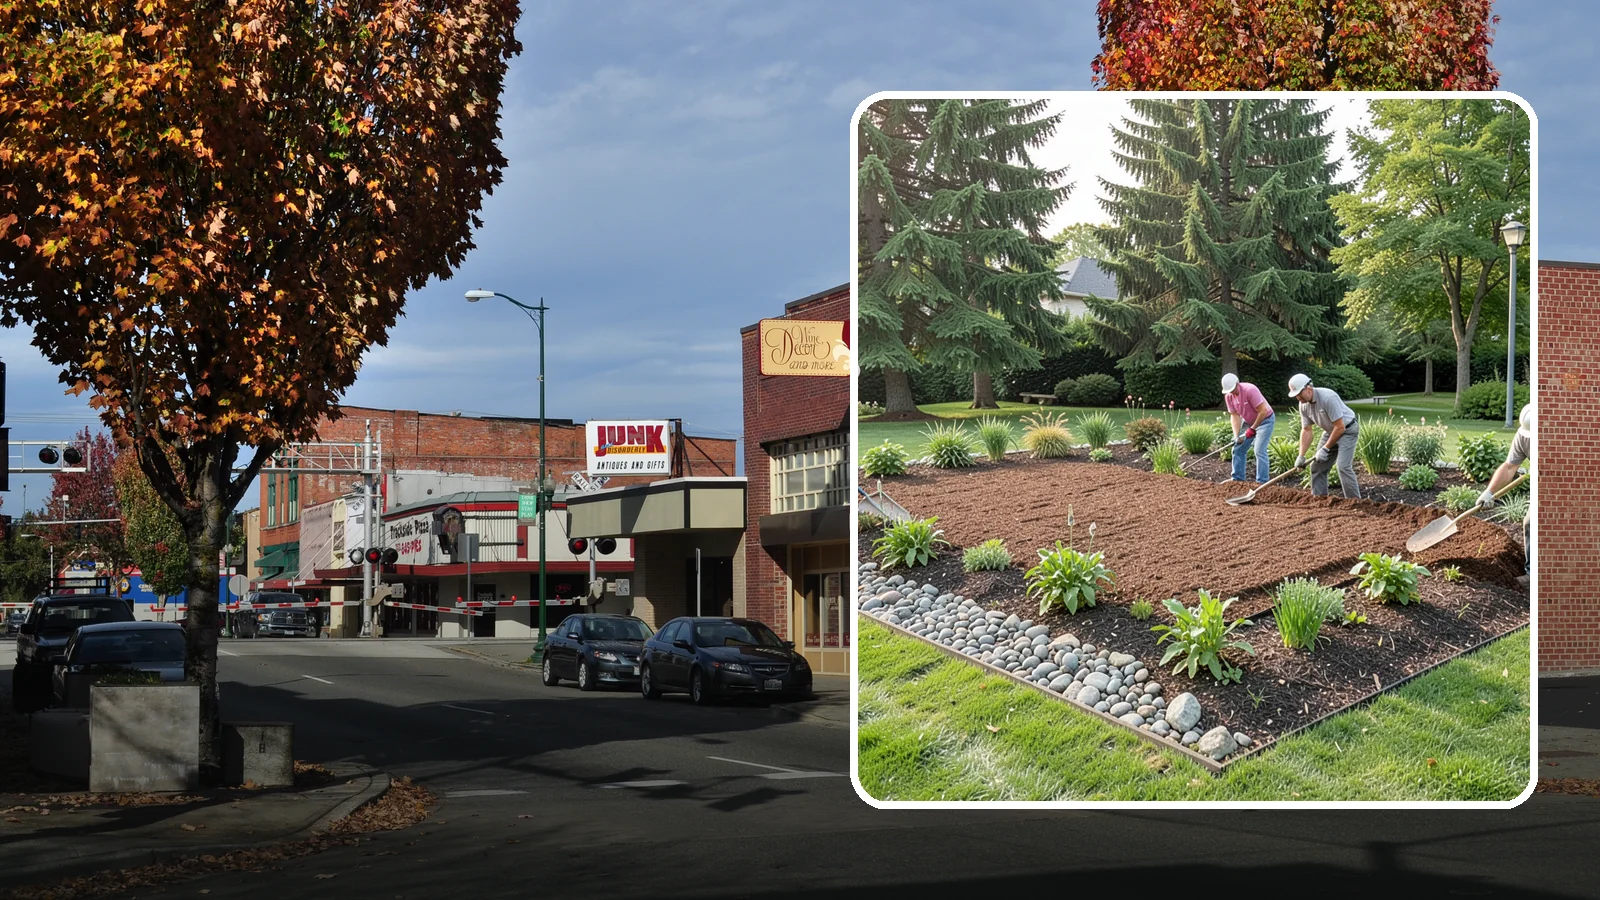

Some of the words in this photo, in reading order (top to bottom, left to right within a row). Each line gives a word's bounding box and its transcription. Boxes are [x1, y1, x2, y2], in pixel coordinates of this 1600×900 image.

[595, 425, 664, 457] JUNK
[607, 446, 646, 454] DISORDERLY
[596, 461, 628, 470] ANTIQUES
[631, 461, 644, 470] AND
[647, 460, 665, 470] GIFTS
[390, 522, 413, 540] Trackside
[414, 519, 429, 535] Pizza
